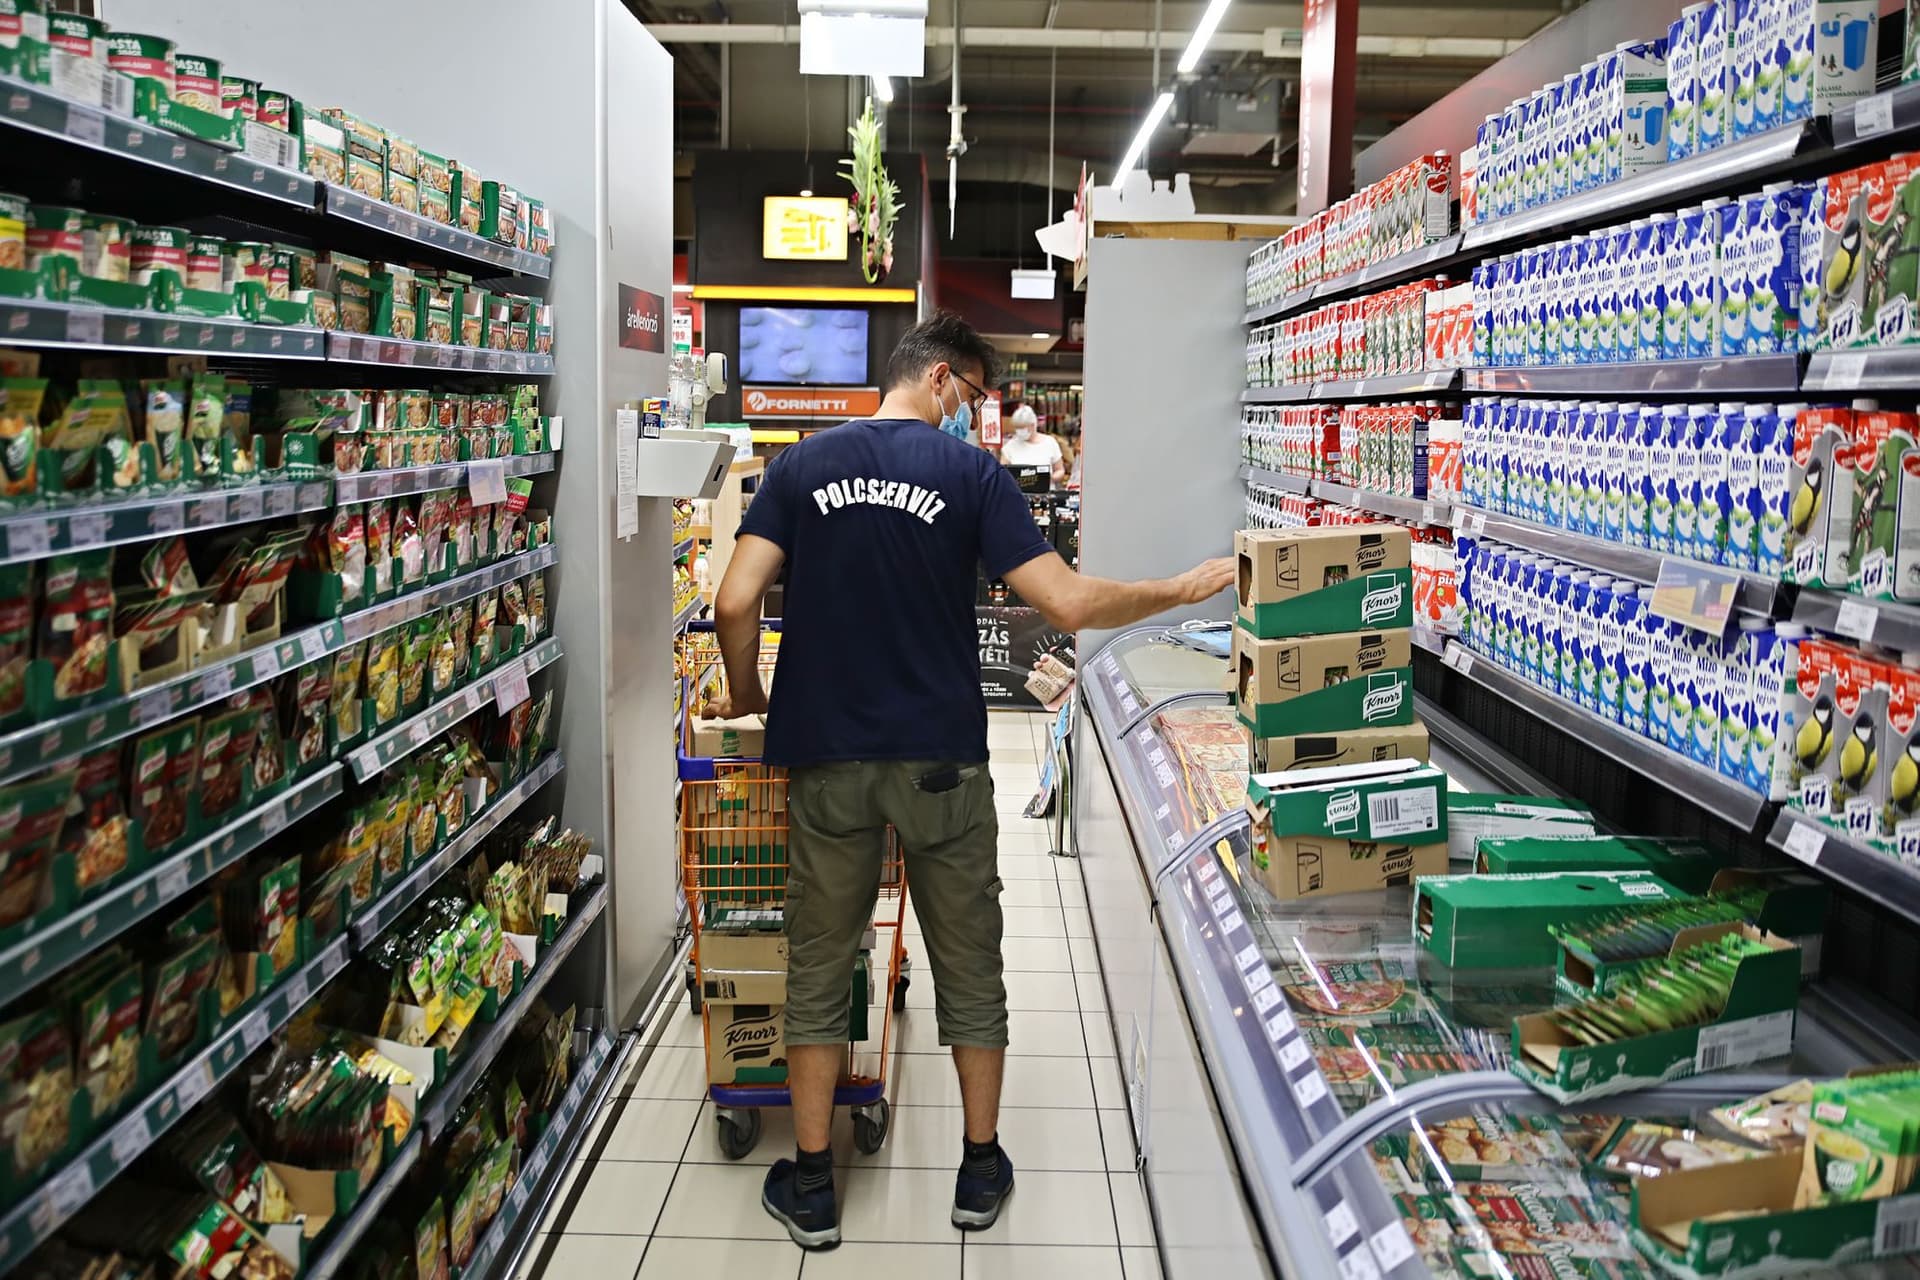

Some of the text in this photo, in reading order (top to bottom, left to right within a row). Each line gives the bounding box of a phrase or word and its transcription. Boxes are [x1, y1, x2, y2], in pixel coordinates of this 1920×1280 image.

[1757, 11, 1781, 36] Mizo
[1737, 28, 1754, 48] Miz
[1702, 40, 1724, 60] Mizo
[1671, 53, 1692, 73] Mizo
[1750, 237, 1775, 256] Mizo
[1801, 230, 1821, 248] Mizo
[1665, 254, 1684, 271] Mizo
[1689, 250, 1710, 266] Mizo
[1619, 264, 1636, 278] Mizo
[1640, 259, 1658, 274] Mizo
[1562, 276, 1576, 289] Mizo
[1579, 272, 1595, 286] Mizo
[1598, 269, 1614, 282] Mizo
[766, 399, 848, 411] FORNETTI
[1569, 443, 1583, 454] Mizo
[1587, 445, 1602, 457] Mizo
[1607, 446, 1623, 459] Mizo
[1628, 449, 1644, 462] Mizo
[1652, 451, 1670, 464] Mizo
[1676, 452, 1695, 466] Mizo
[1731, 456, 1751, 471] Mizo
[1762, 458, 1785, 475] Mizo
[1356, 547, 1386, 562] Knorr
[1864, 559, 1883, 584] tej
[1365, 593, 1399, 612] Knorr
[1543, 602, 1556, 616] Mizo
[1562, 609, 1574, 624] Mizo
[1580, 615, 1594, 631] Mizo
[1602, 623, 1618, 639] Mizo
[1625, 631, 1646, 647] Mizo
[1357, 648, 1386, 663] Knorr
[1672, 647, 1692, 663] Mizo
[1696, 657, 1717, 673] Mizo
[1724, 665, 1747, 684] Mizo
[1757, 673, 1779, 692] Mizo
[1365, 692, 1400, 710] Knorr
[1805, 787, 1826, 807] tej
[1329, 803, 1359, 817] Knorr
[1849, 807, 1871, 831] tej
[1382, 856, 1414, 872] Knorr
[725, 1026, 777, 1047] Knorr
